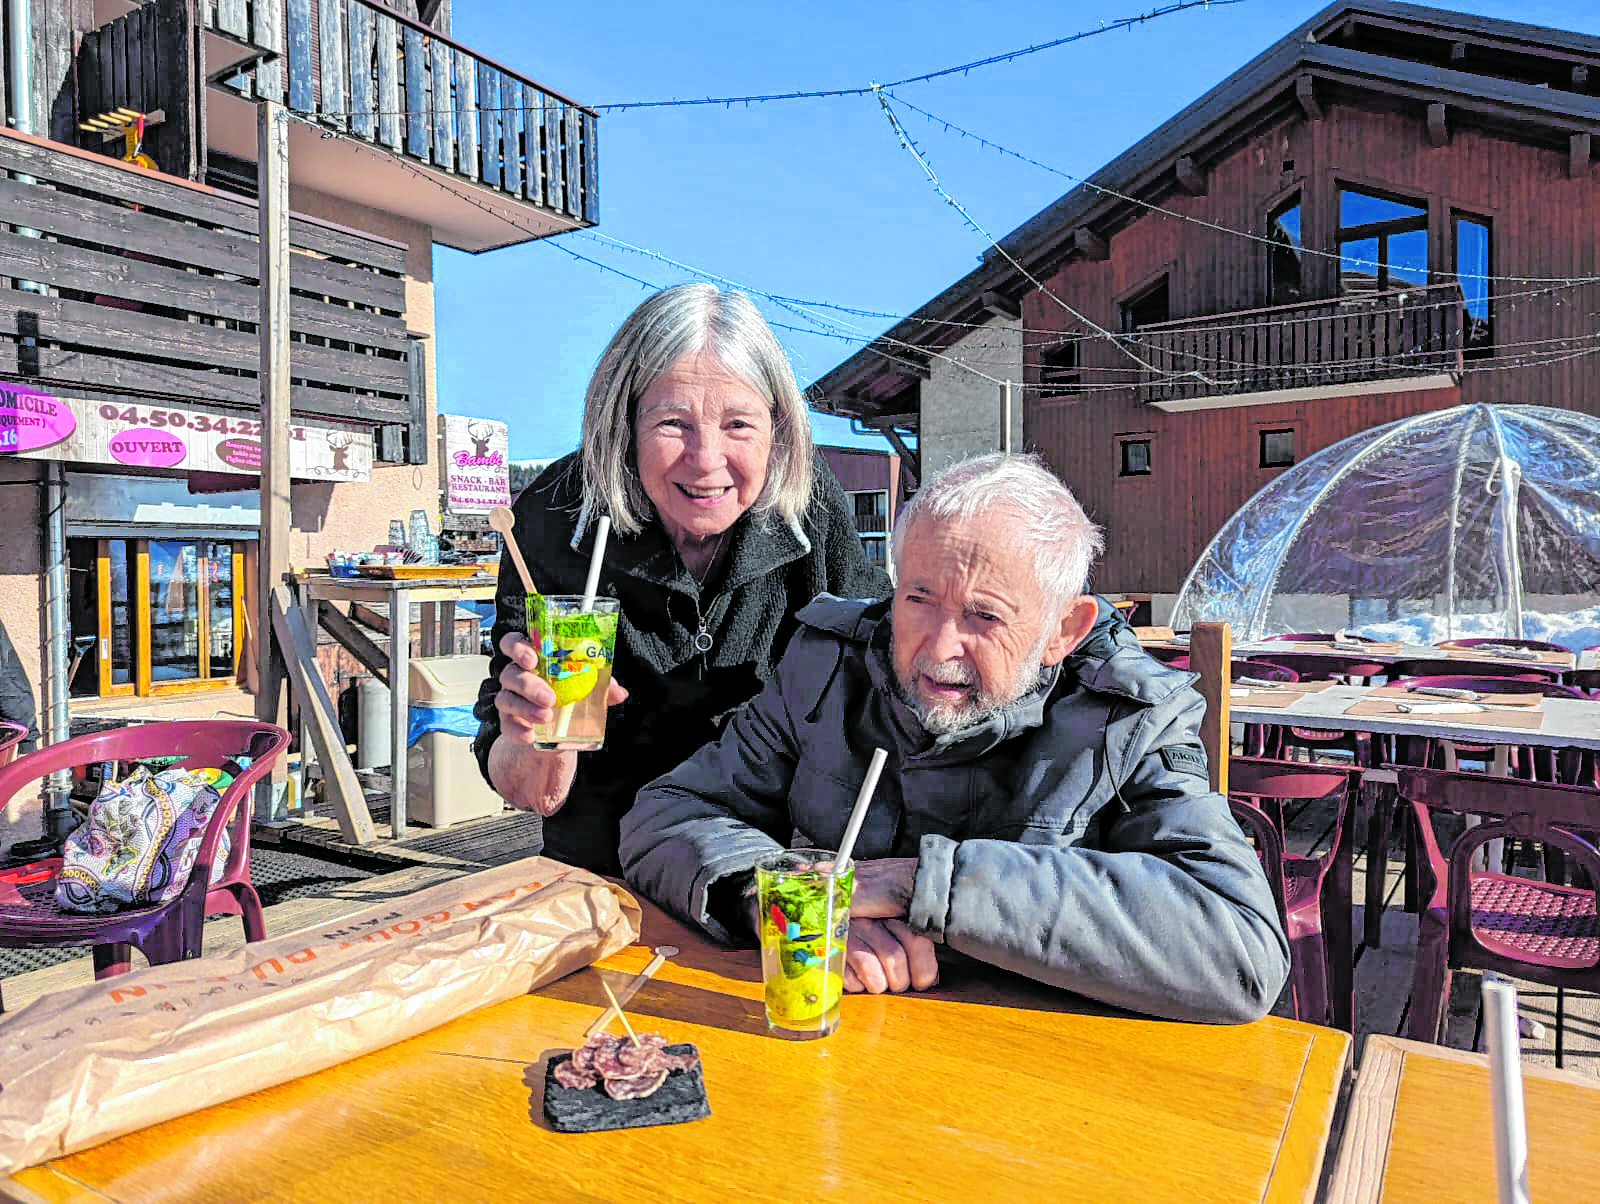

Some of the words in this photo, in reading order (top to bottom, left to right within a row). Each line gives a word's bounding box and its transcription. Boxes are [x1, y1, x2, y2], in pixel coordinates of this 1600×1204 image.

[99, 404, 306, 441] 04.50.34.221
[112, 441, 182, 453] OUVERT
[453, 450, 503, 467] Bambi
[451, 475, 482, 484] SNACK
[489, 477, 506, 486] BAR
[452, 484, 506, 493] RESTAURANT
[250, 947, 318, 980] DU
